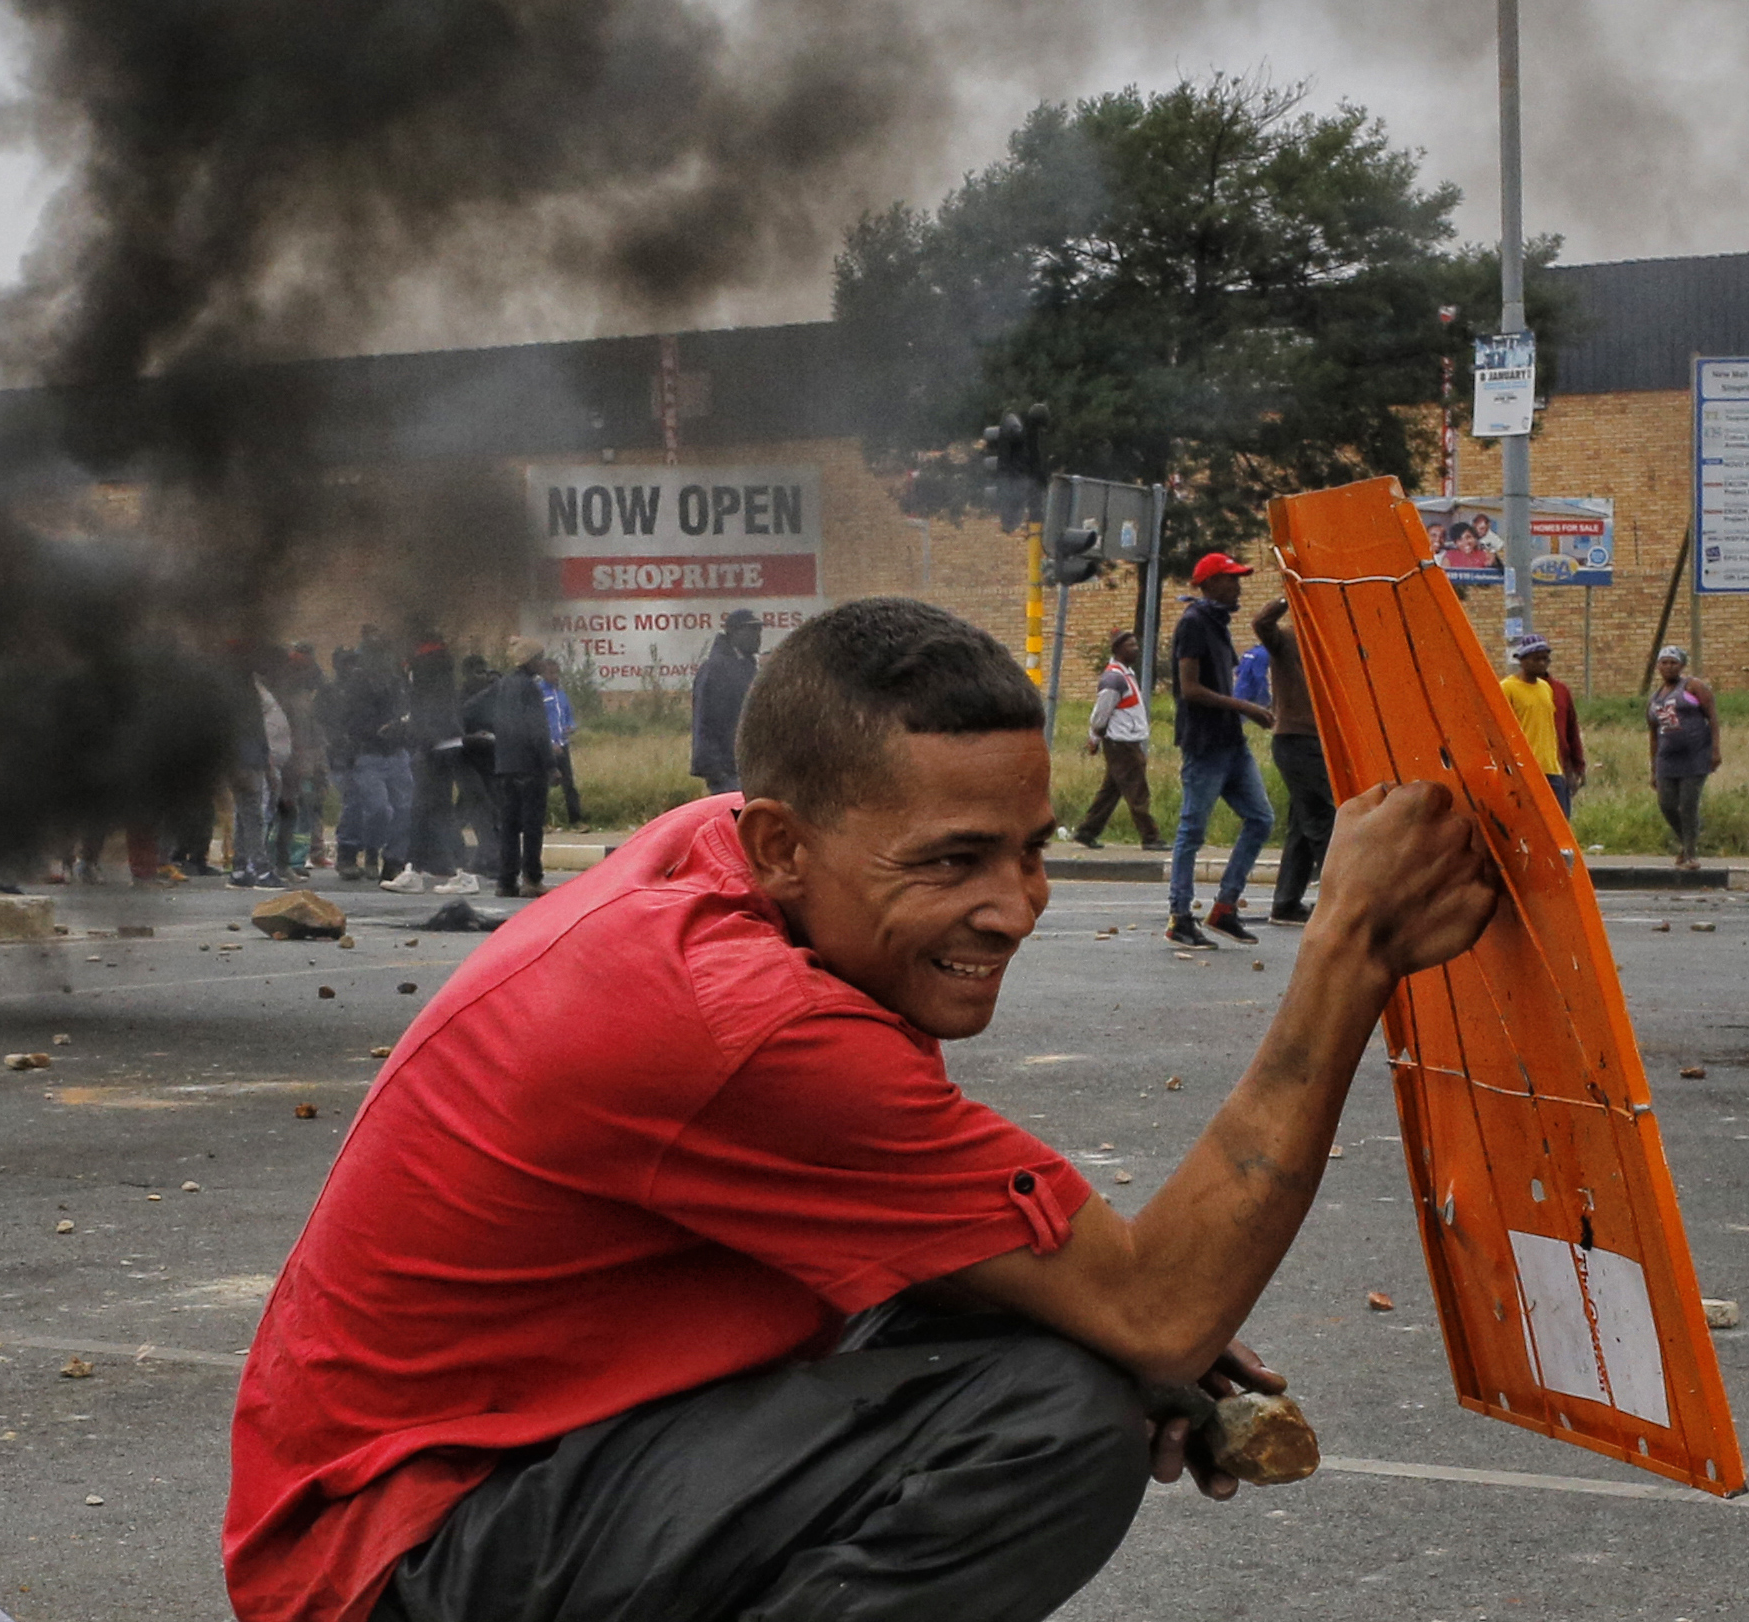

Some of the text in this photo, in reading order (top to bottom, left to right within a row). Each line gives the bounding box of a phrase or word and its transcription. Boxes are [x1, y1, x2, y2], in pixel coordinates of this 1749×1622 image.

[1488, 370, 1525, 381] JANUARY
[549, 485, 803, 536] NOW OPEN
[1534, 523, 1599, 532] HOMES FOR SALE
[592, 563, 764, 590] SHOPRITE
[551, 611, 803, 632] MAGIC MOTOR SRES
[581, 639, 626, 656] TEL:
[600, 665, 641, 678] OPEN
